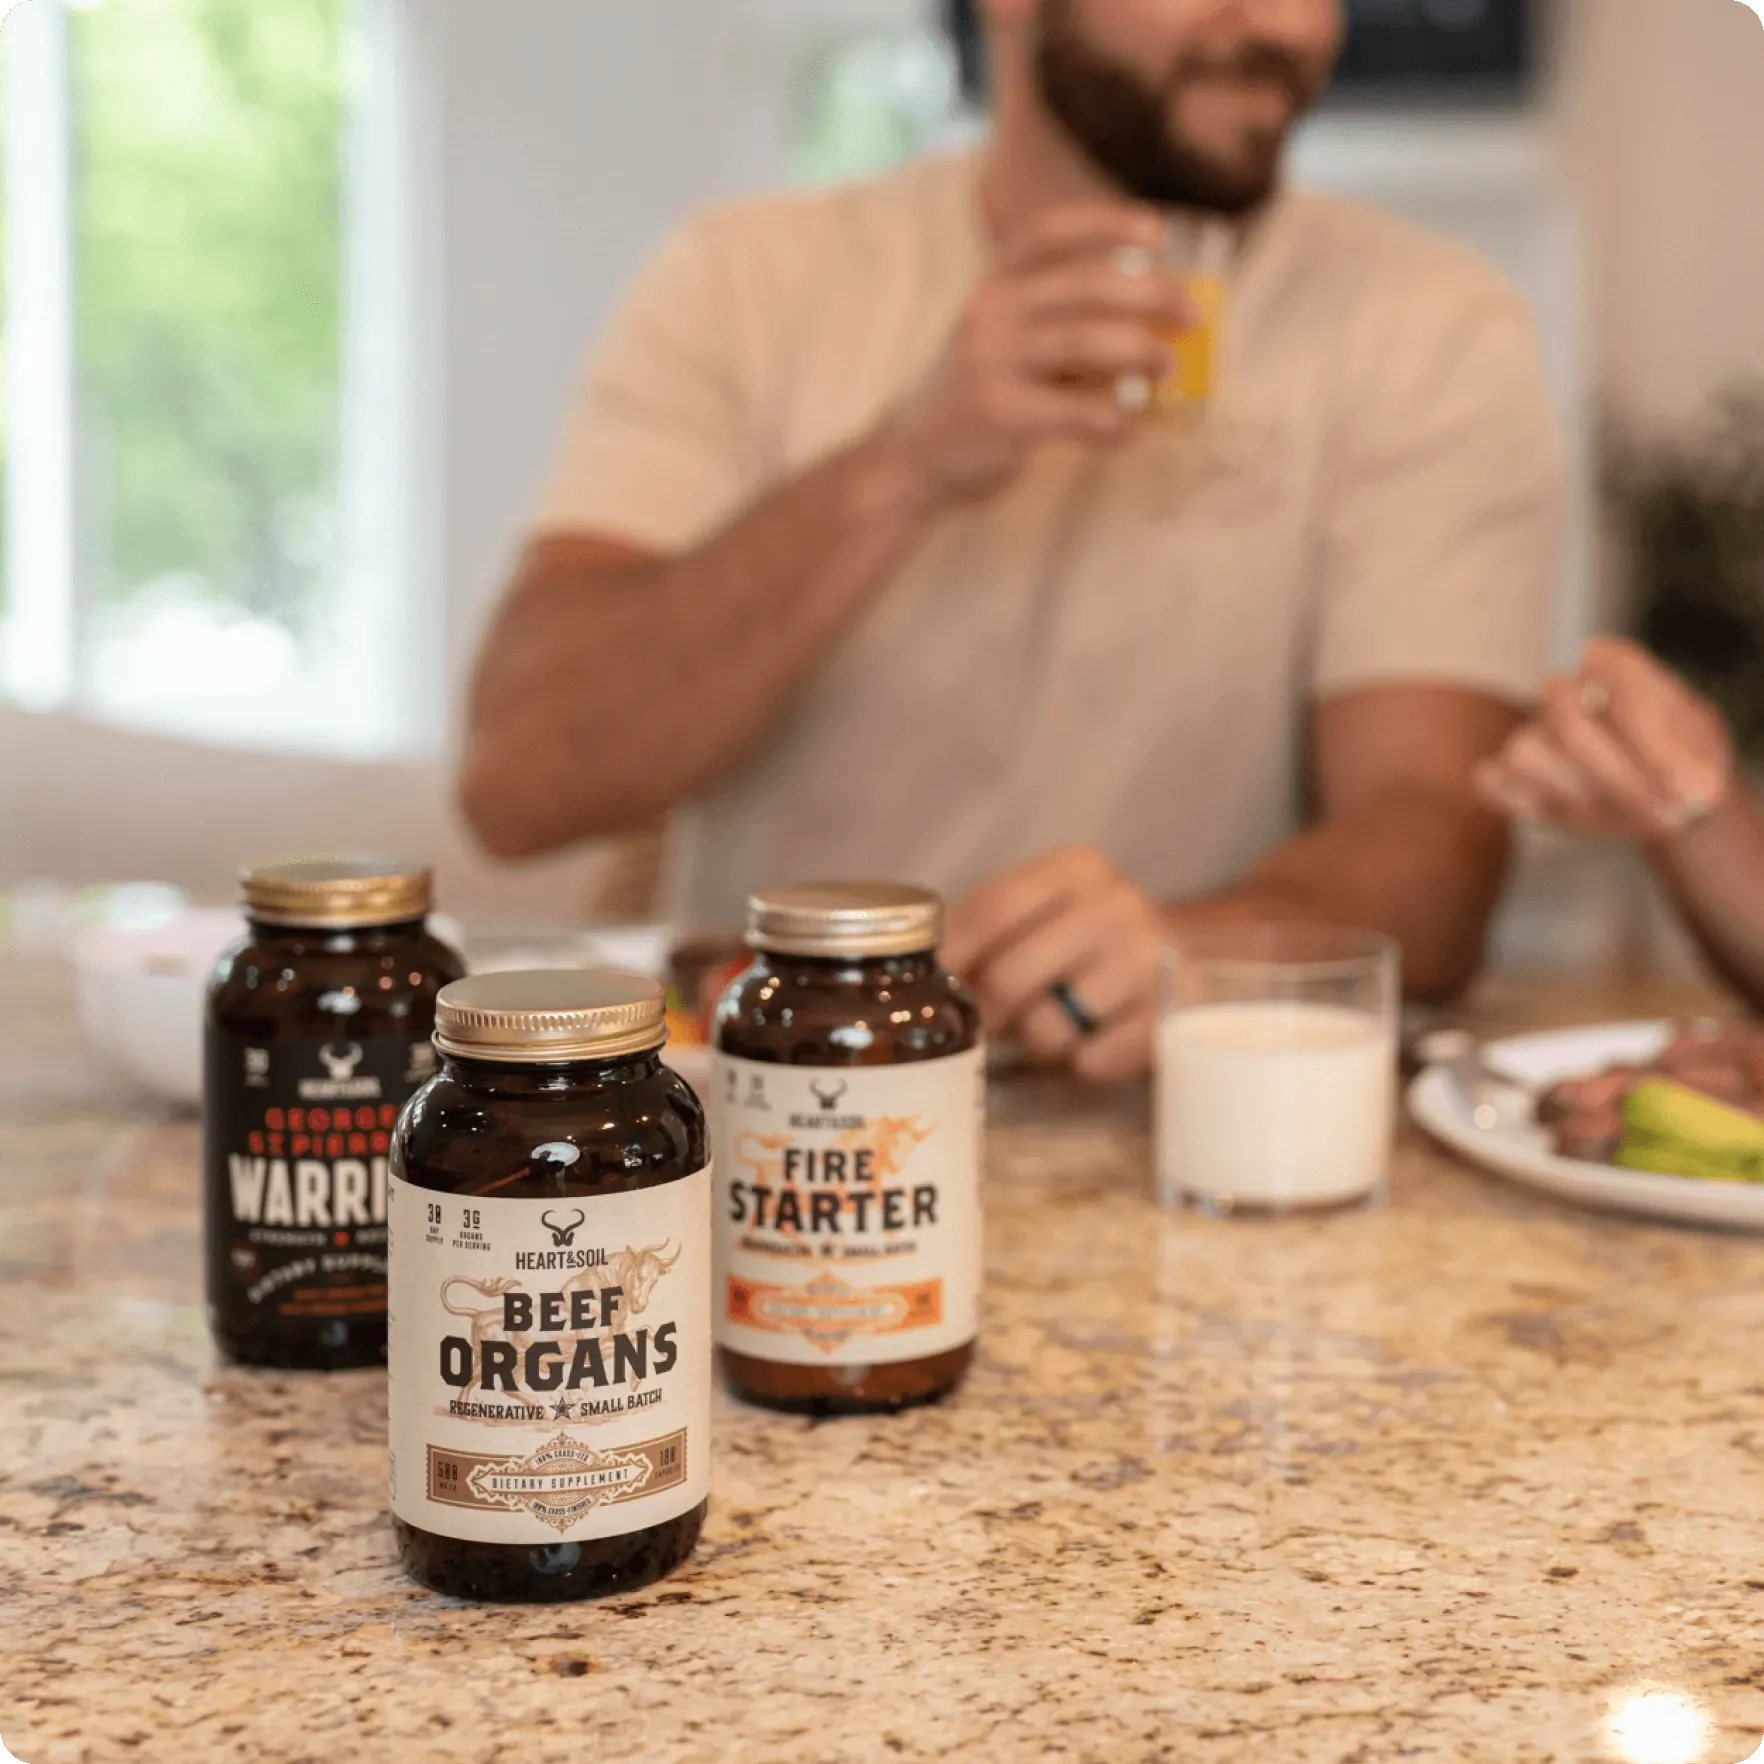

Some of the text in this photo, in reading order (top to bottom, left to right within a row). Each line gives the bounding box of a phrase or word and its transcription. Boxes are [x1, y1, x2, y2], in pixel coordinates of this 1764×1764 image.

[783, 1148, 875, 1182] FIRE
[228, 1153, 388, 1227] WARRI
[728, 1180, 938, 1233] STARTER
[515, 1248, 609, 1270] HEART&SOIL
[503, 1286, 624, 1332] BEEF
[439, 1321, 678, 1392] ORGANS
[449, 1388, 662, 1420] REGENERATIVE SMALL BATCH
[492, 1468, 628, 1490] DIETARY SUPPLEMENT
